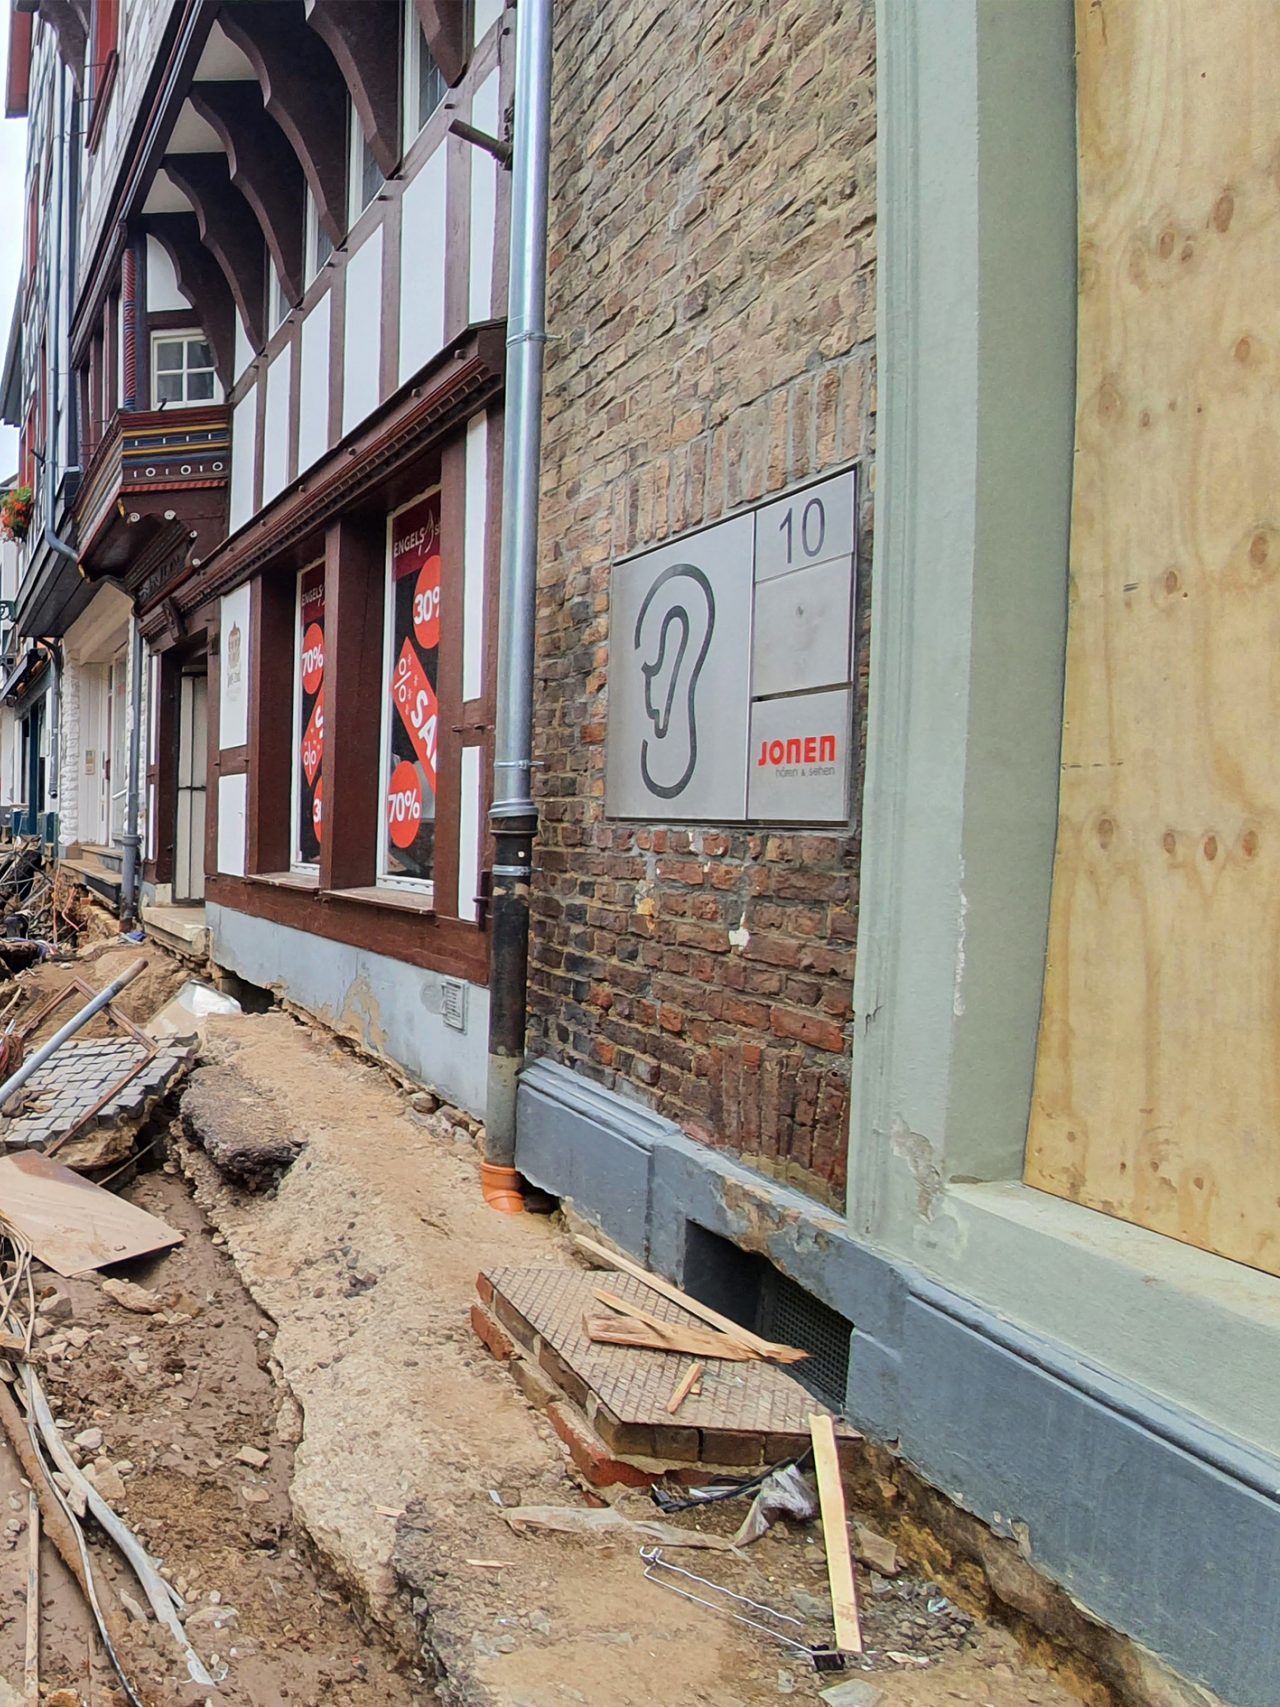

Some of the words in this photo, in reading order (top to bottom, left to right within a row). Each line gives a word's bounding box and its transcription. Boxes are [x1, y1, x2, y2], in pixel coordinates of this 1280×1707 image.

[393, 527, 425, 558] ENGELS
[779, 497, 825, 564] 10
[301, 643, 323, 677] 70%
[758, 735, 836, 767] JONEN
[387, 788, 420, 823] 70%
